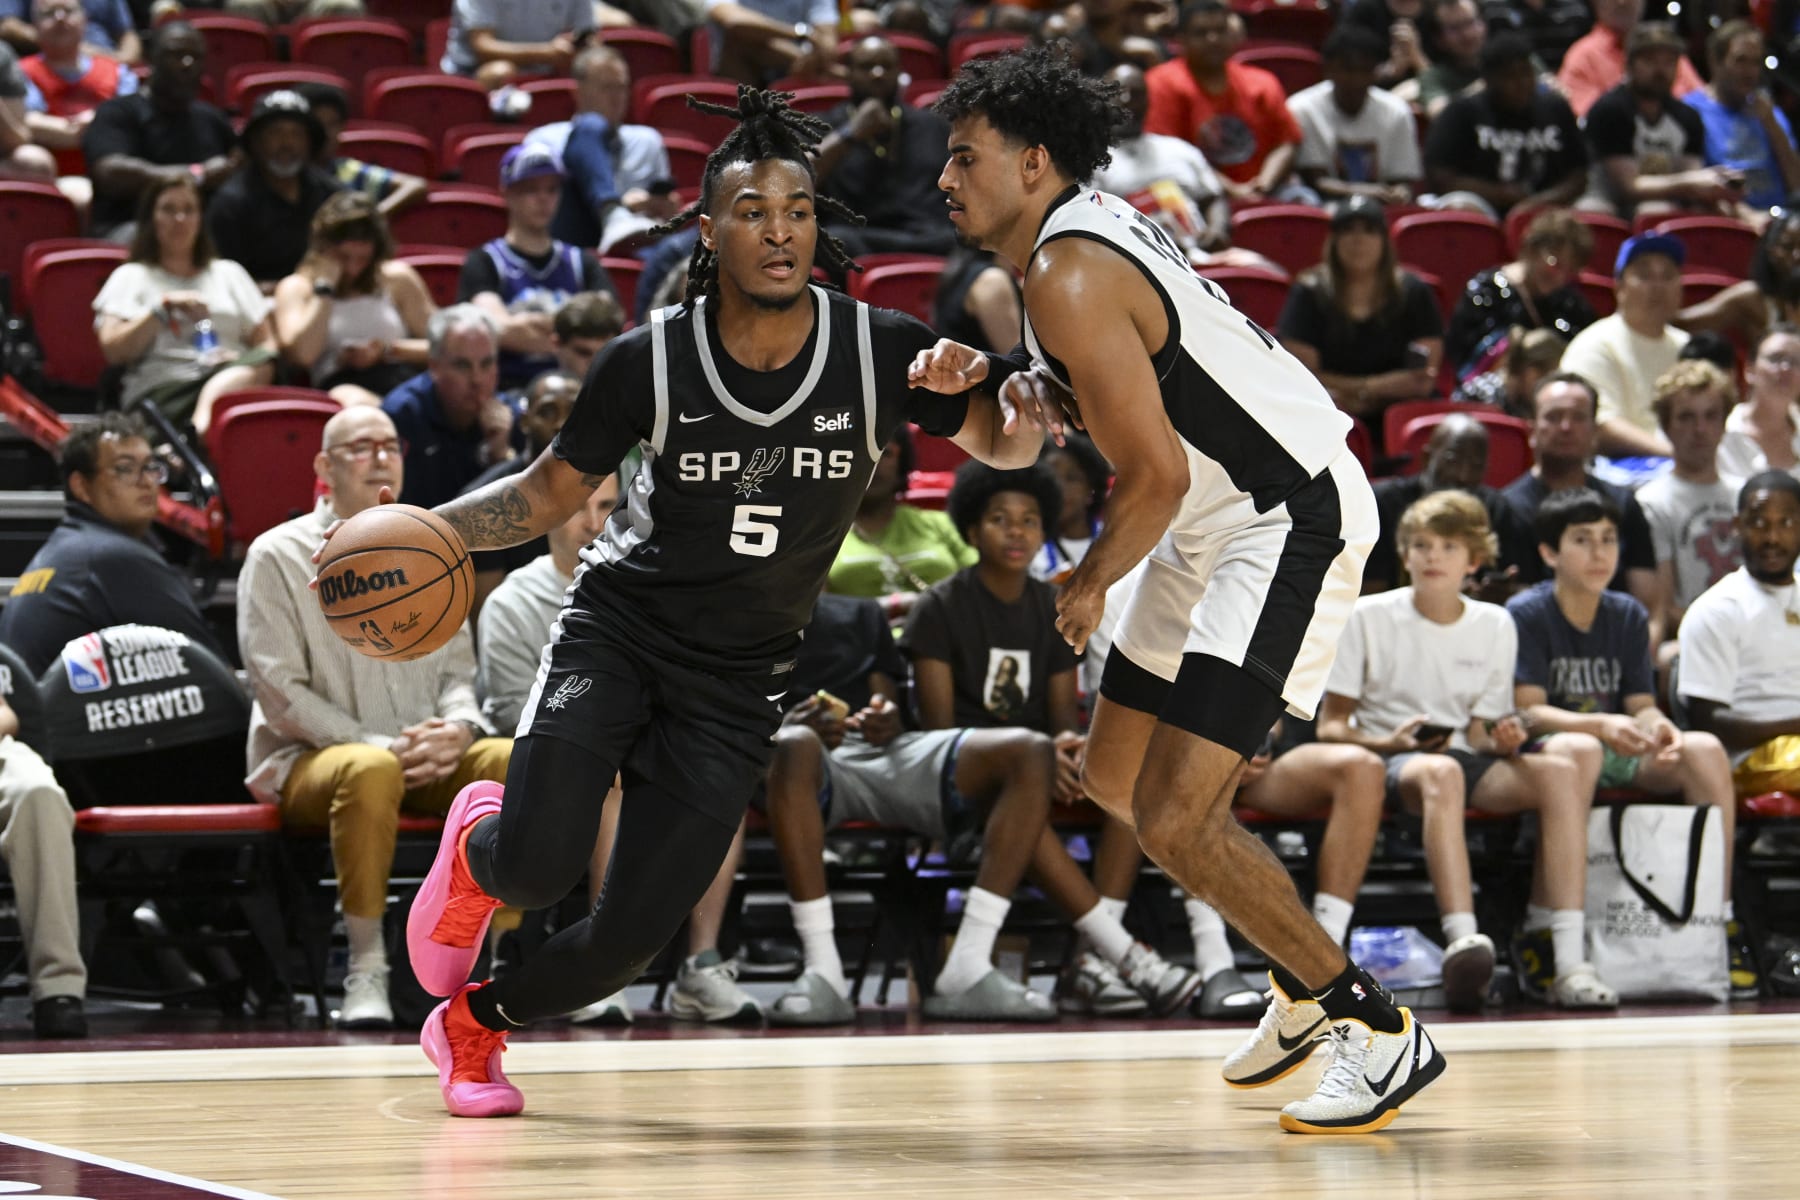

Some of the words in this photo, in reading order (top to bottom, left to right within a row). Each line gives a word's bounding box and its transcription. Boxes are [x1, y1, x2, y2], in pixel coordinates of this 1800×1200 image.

[729, 505, 782, 557] 5
[320, 568, 409, 606] Wilson
[112, 649, 190, 686] LEAGUE
[85, 685, 204, 732] RESERVED
